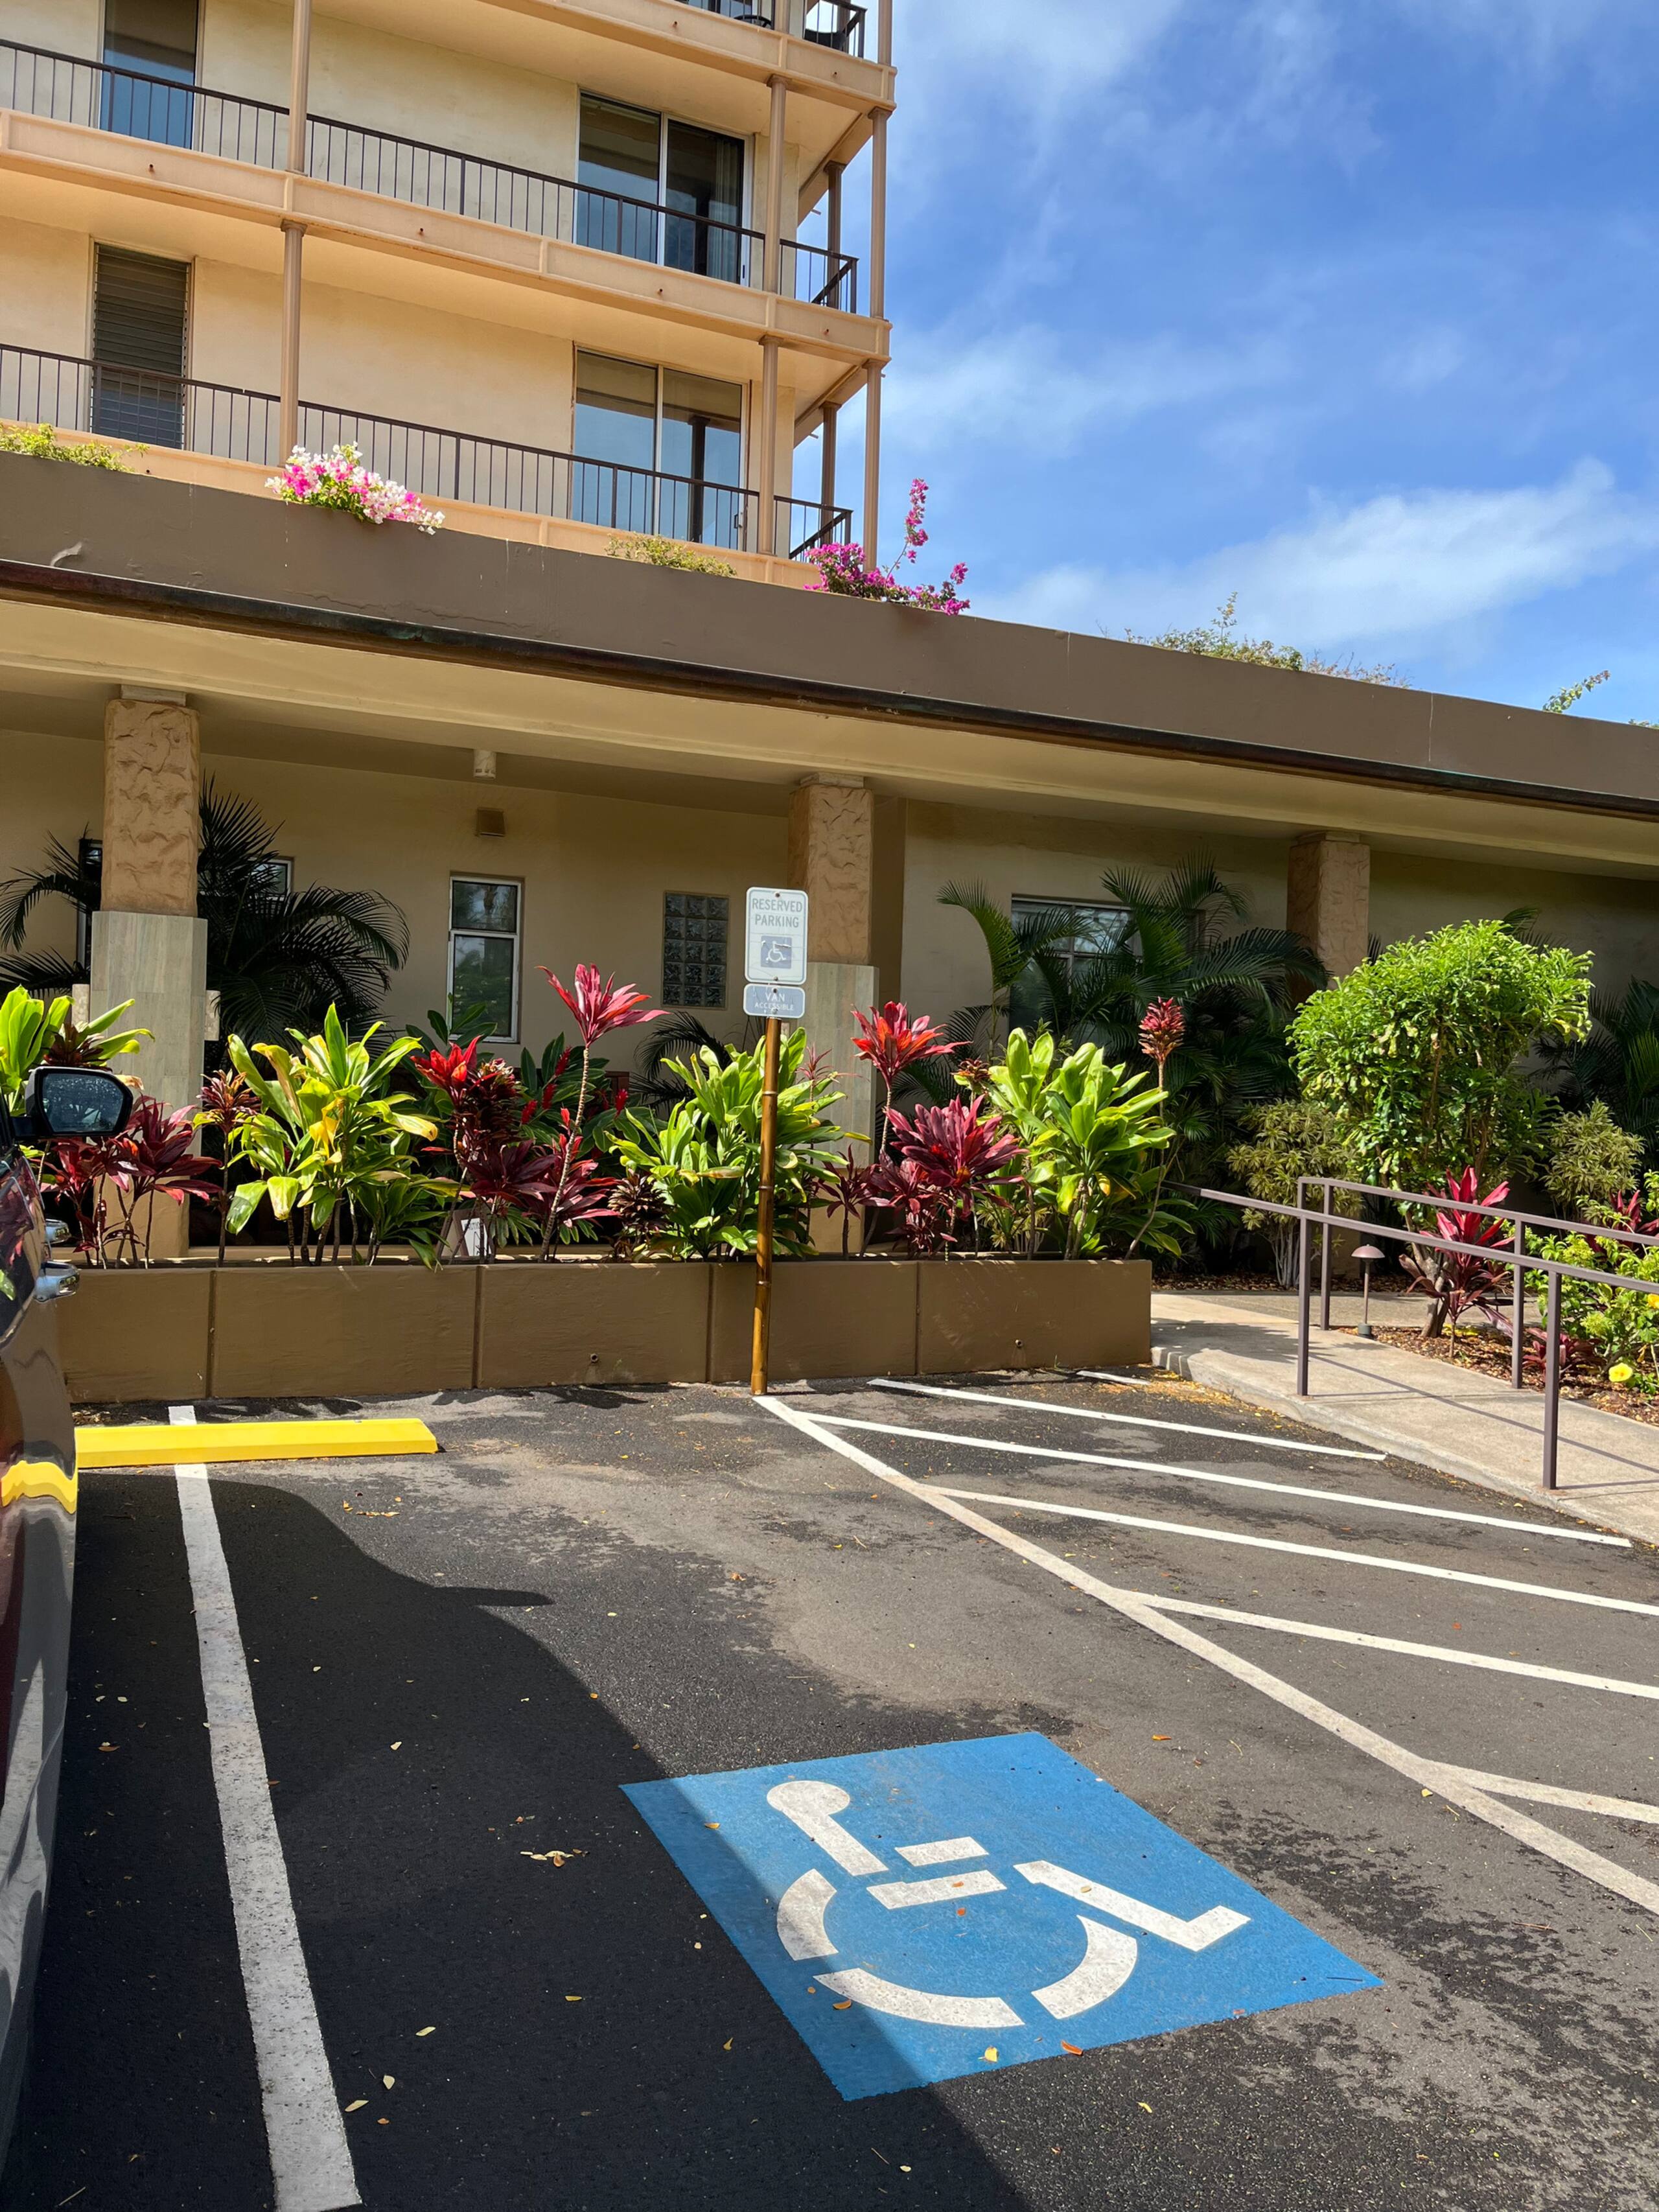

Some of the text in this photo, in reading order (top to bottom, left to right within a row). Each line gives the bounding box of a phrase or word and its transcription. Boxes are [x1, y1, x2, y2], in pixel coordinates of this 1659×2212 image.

[752, 898, 803, 913] RESERVED
[754, 914, 799, 928] PARKING
[765, 992, 785, 1003] VAN
